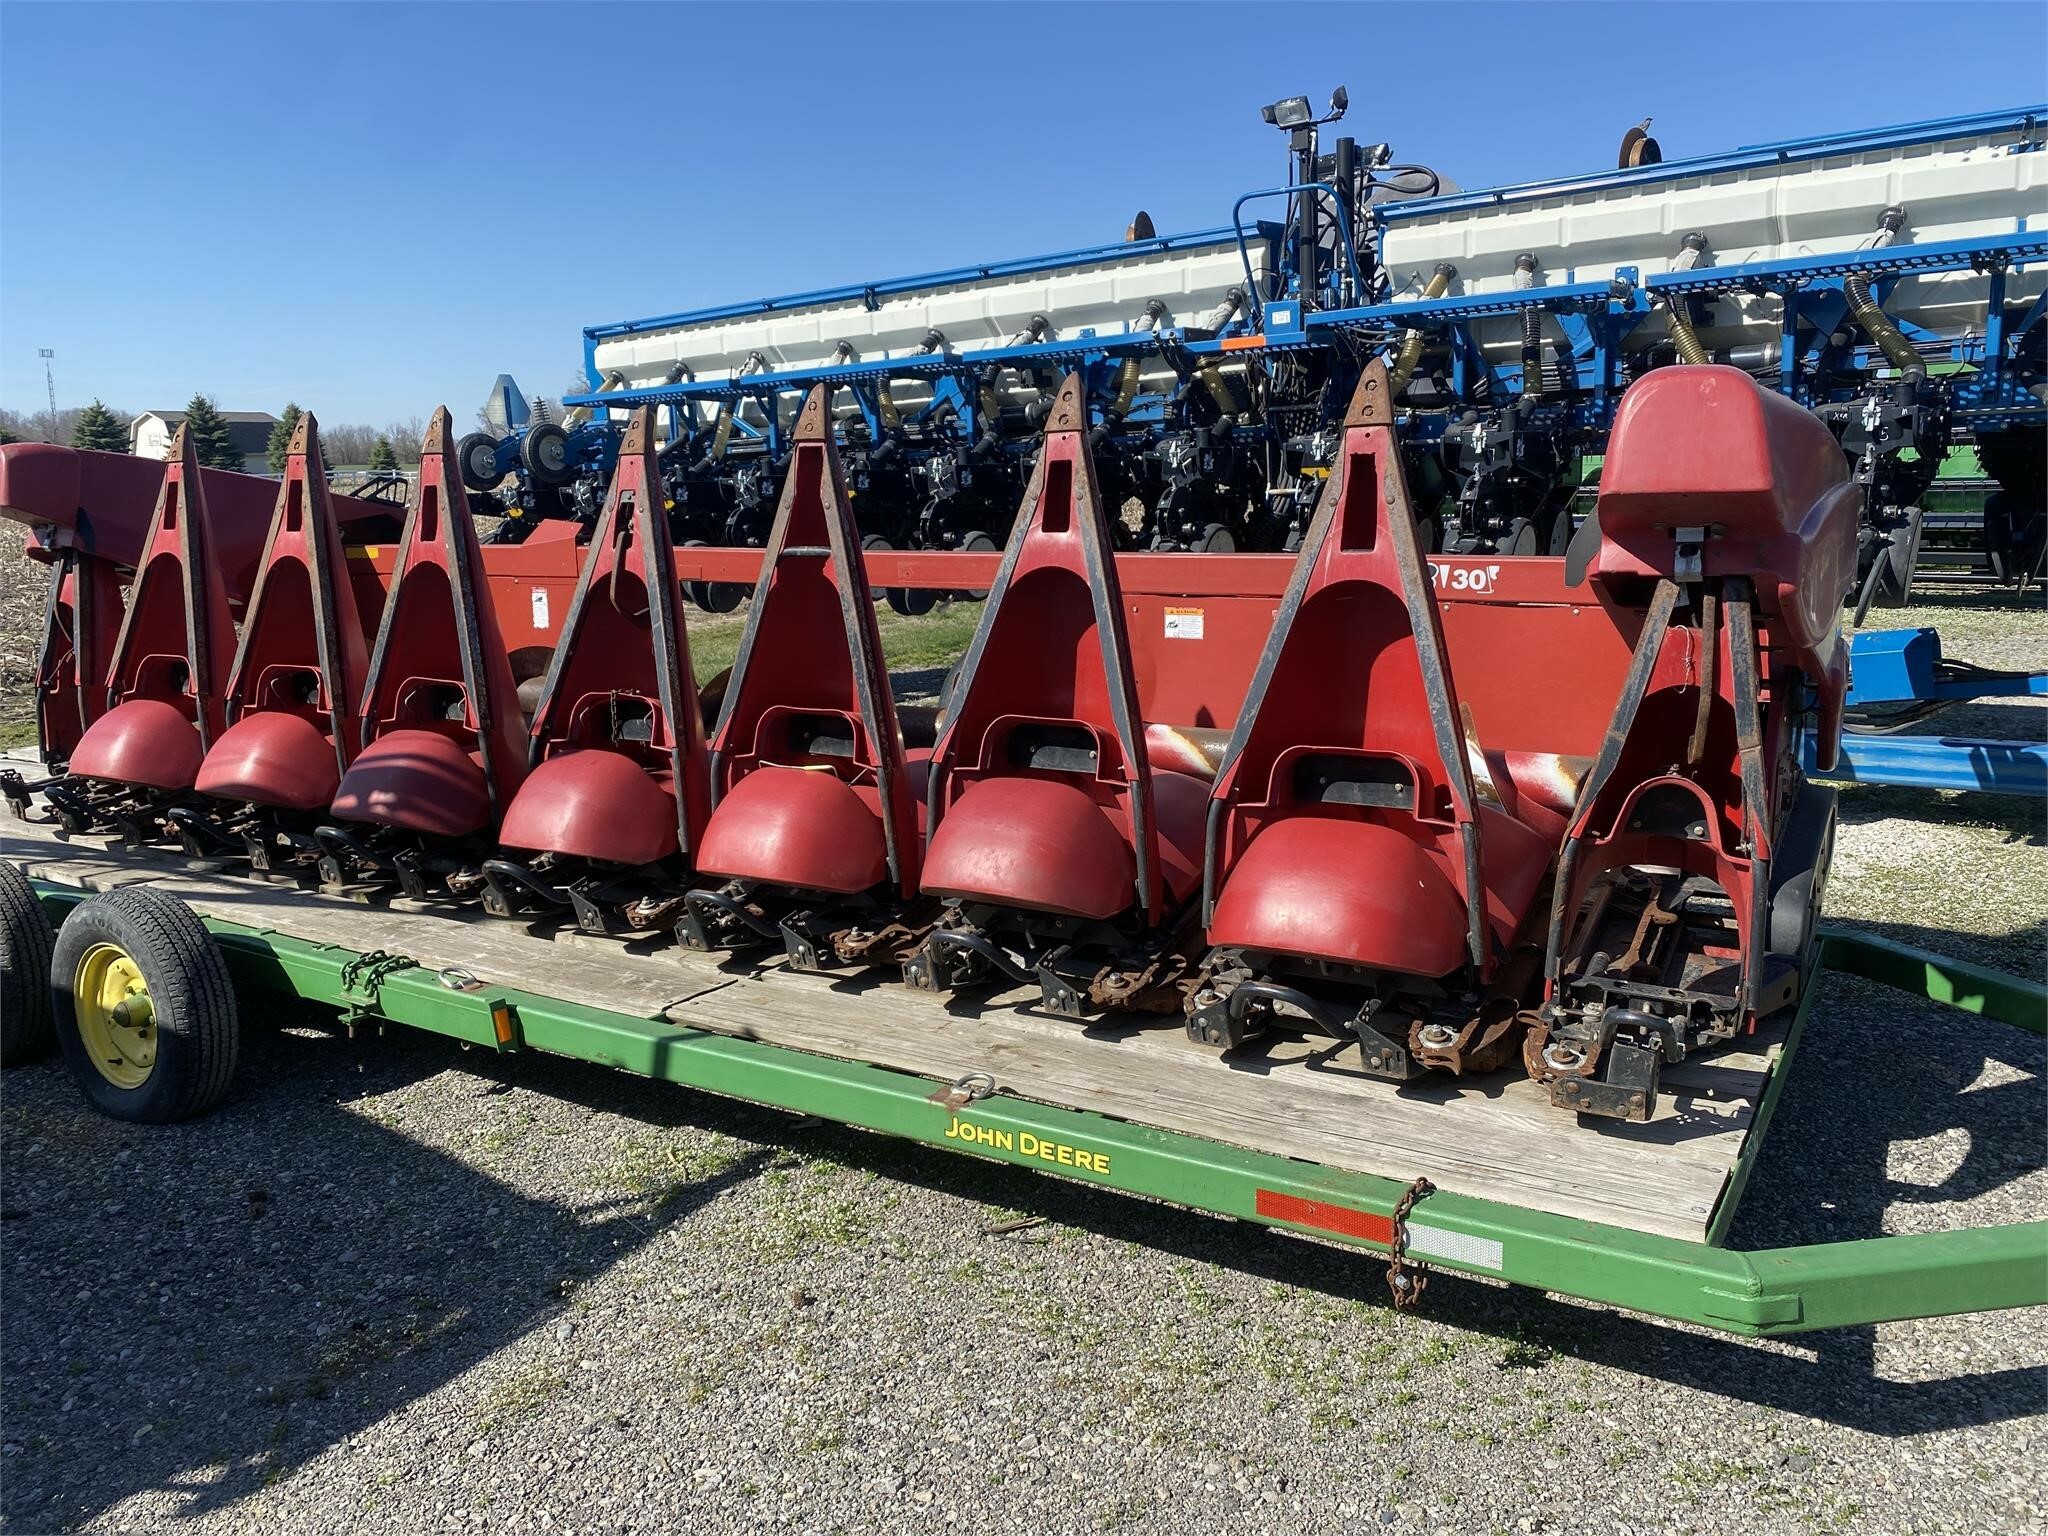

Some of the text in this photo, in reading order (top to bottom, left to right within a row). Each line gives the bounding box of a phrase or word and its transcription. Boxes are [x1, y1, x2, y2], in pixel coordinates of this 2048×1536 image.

[1451, 568, 1487, 590] 30
[944, 1116, 1111, 1176] JOHN DEERE
